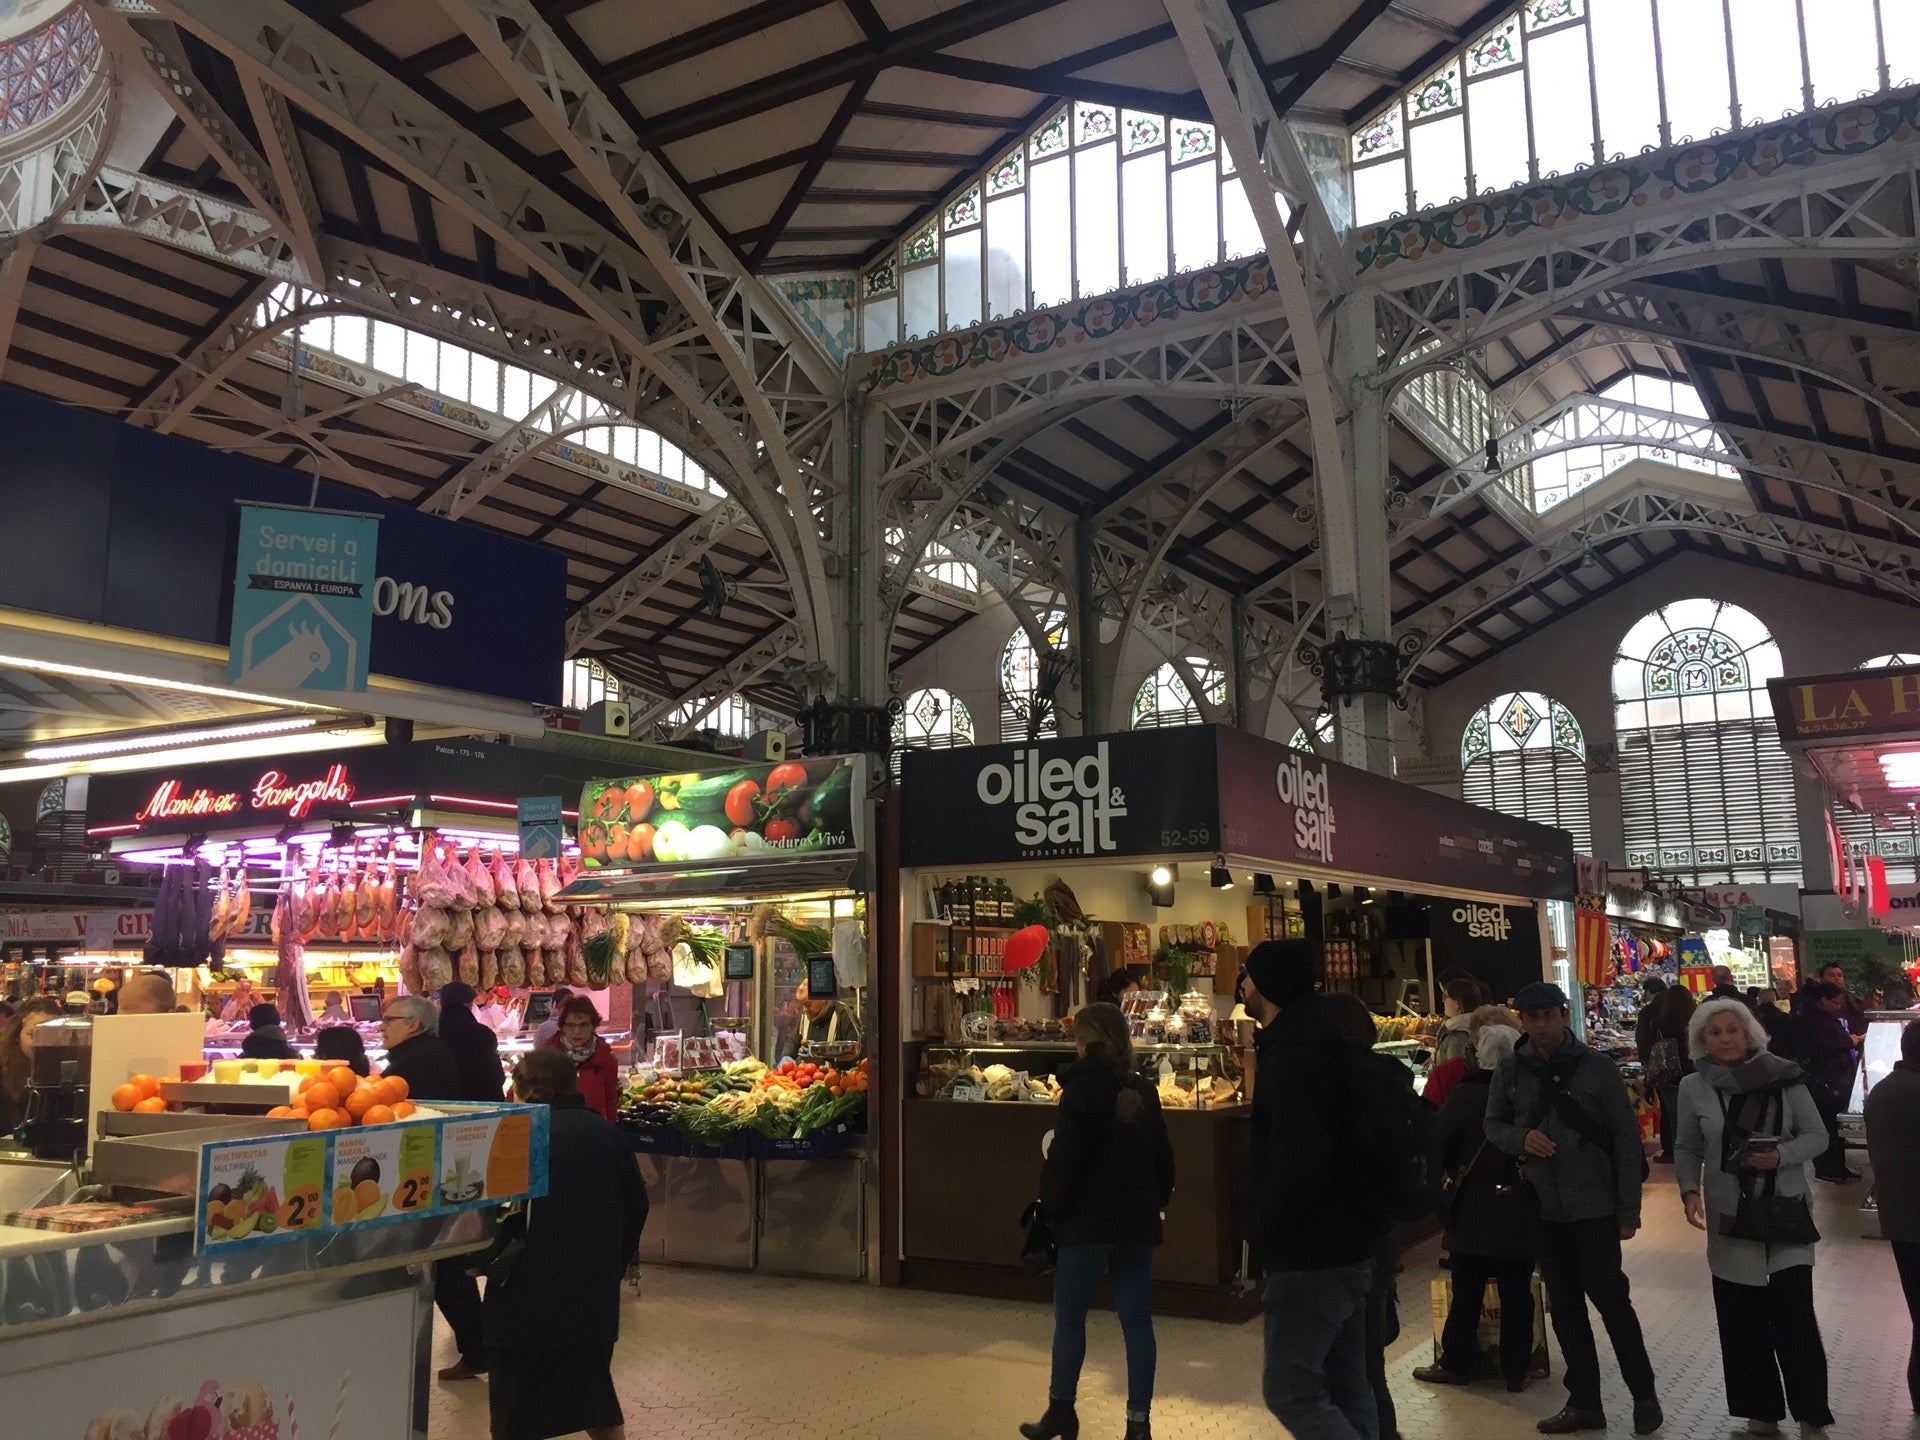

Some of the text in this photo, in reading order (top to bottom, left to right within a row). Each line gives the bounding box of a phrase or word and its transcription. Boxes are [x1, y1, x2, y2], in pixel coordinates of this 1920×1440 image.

[259, 524, 358, 556] Servei a
[256, 553, 357, 581] domicili
[273, 579, 354, 595] ESPANYA I EUROPA
[1798, 684, 1873, 722] LA
[252, 763, 351, 817] Gargallo
[976, 741, 1126, 806] oiled &
[1276, 754, 1329, 806] oiled
[1014, 800, 1128, 854] salt
[1160, 828, 1210, 847] 52-59
[1294, 806, 1336, 863] salt
[1452, 903, 1505, 923] oiled
[1468, 922, 1512, 941] salt
